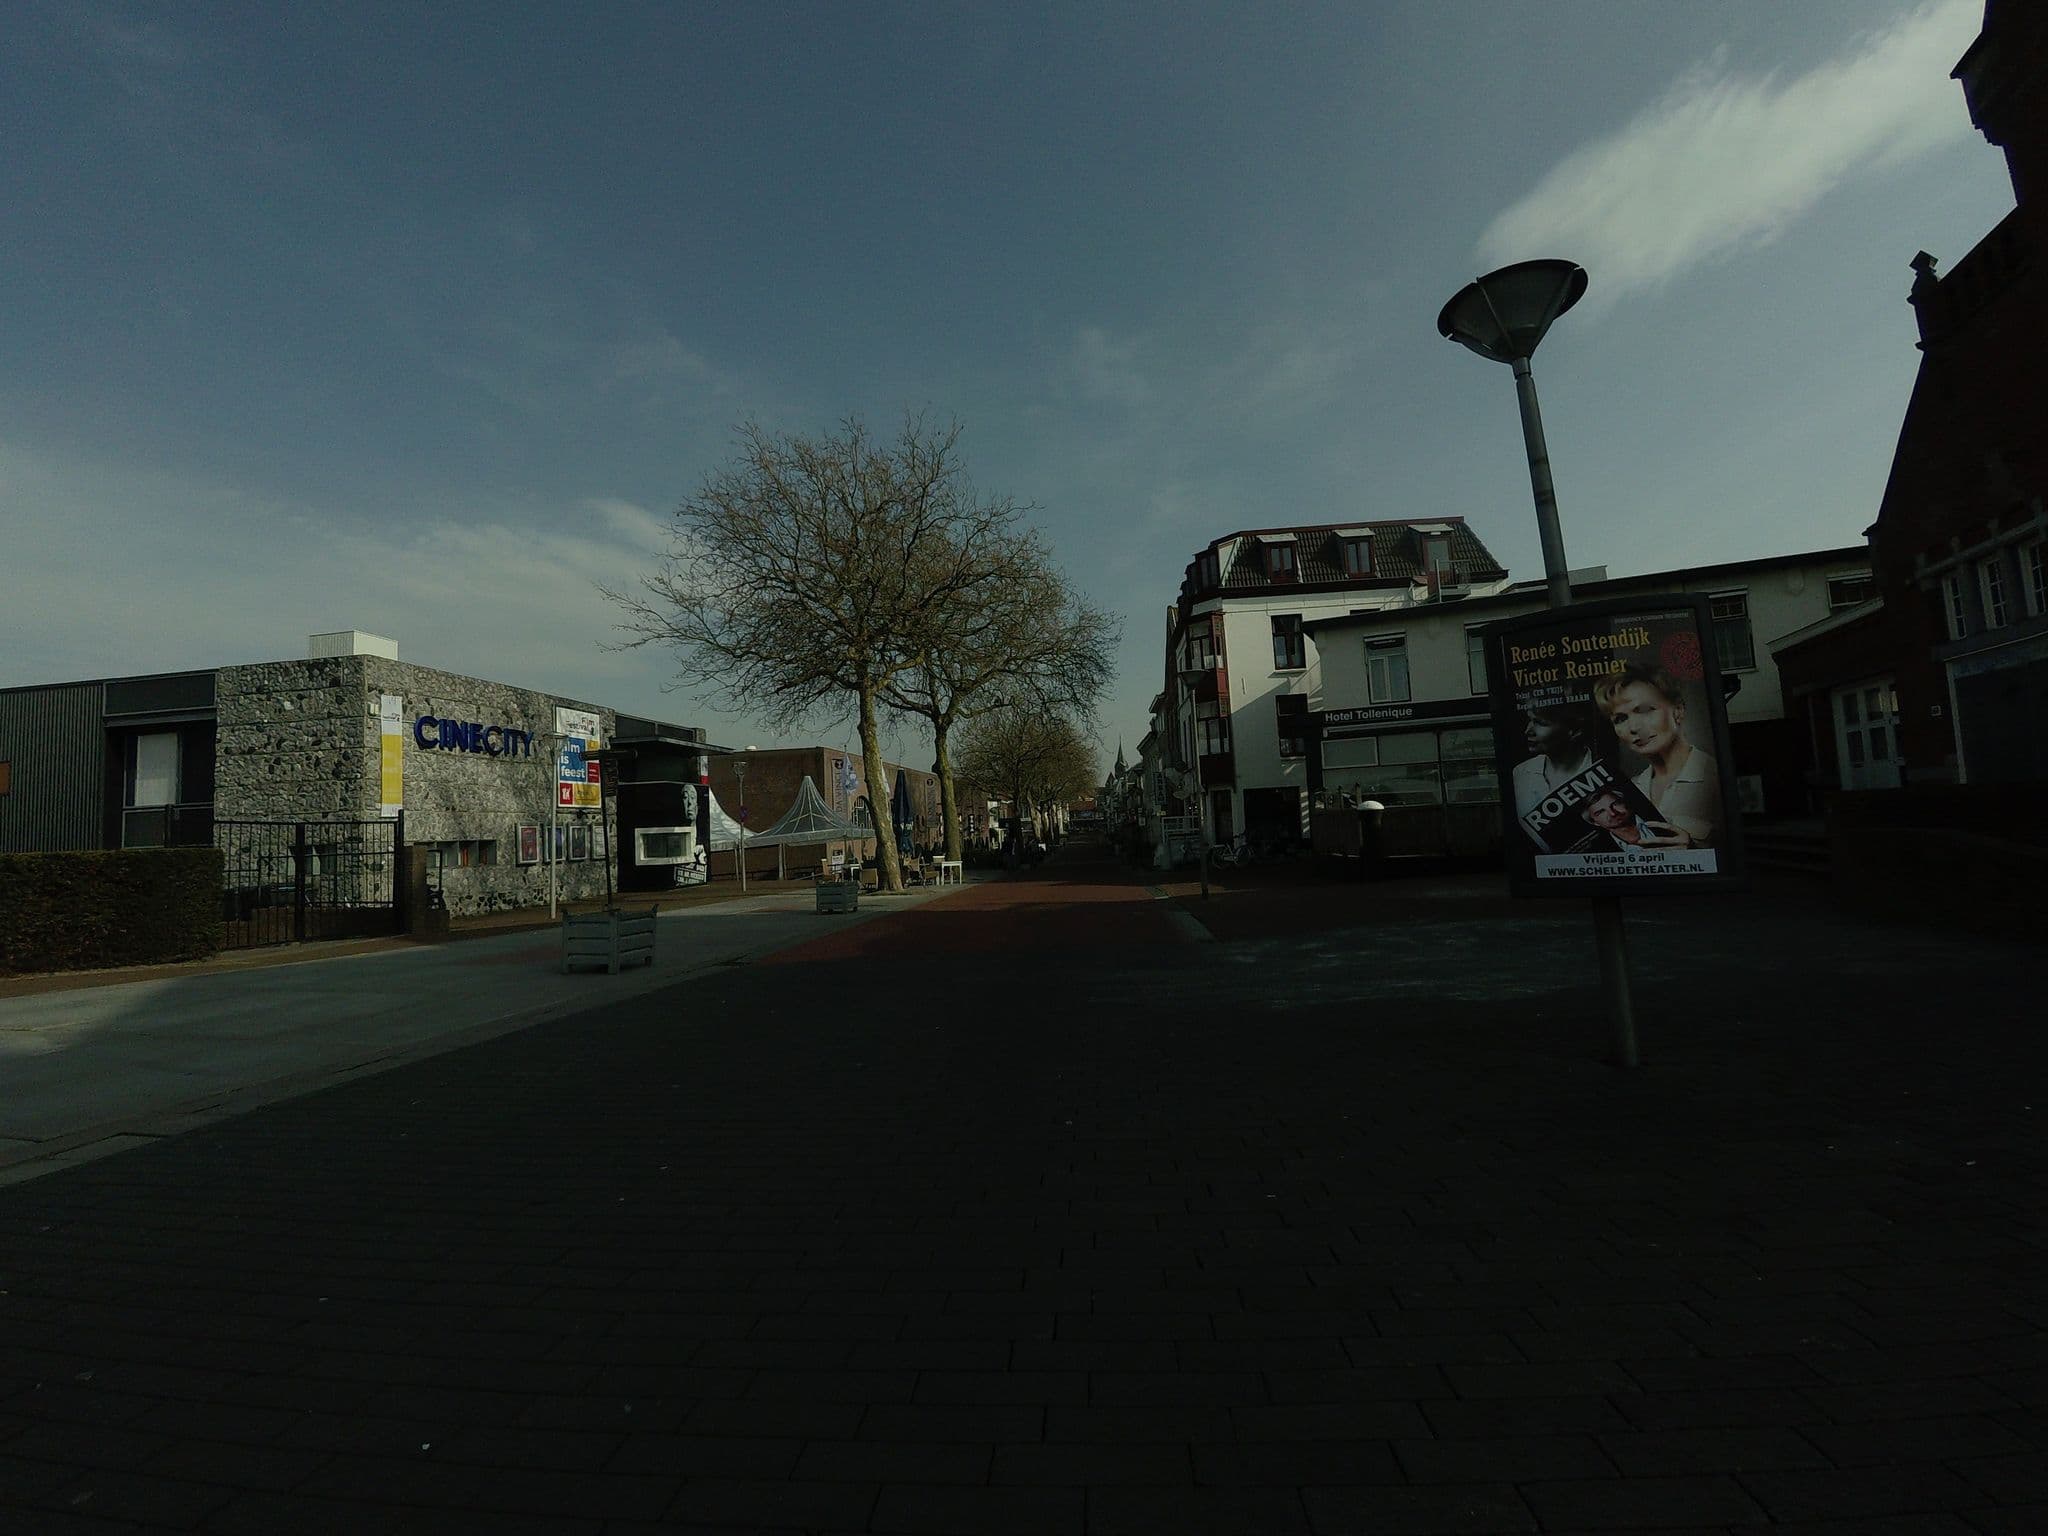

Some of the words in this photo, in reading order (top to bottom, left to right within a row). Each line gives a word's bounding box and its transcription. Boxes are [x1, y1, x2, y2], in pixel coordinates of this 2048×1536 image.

[1511, 640, 1556, 664] Renée
[1561, 627, 1650, 655] Soutendijk
[1513, 667, 1559, 688] Victor
[1565, 656, 1628, 680] Reinier
[1325, 711, 1353, 722] Hotel
[1355, 707, 1413, 719] Tollenique
[414, 715, 534, 758] CINECITY
[560, 764, 586, 778] feest
[1527, 764, 1615, 832] ROEM!
[1548, 864, 1704, 876] WWW.SCHELDETHEATER.NL
[1583, 854, 1625, 866] Vrijdag
[1628, 854, 1636, 863] 6
[1639, 853, 1665, 865] april
